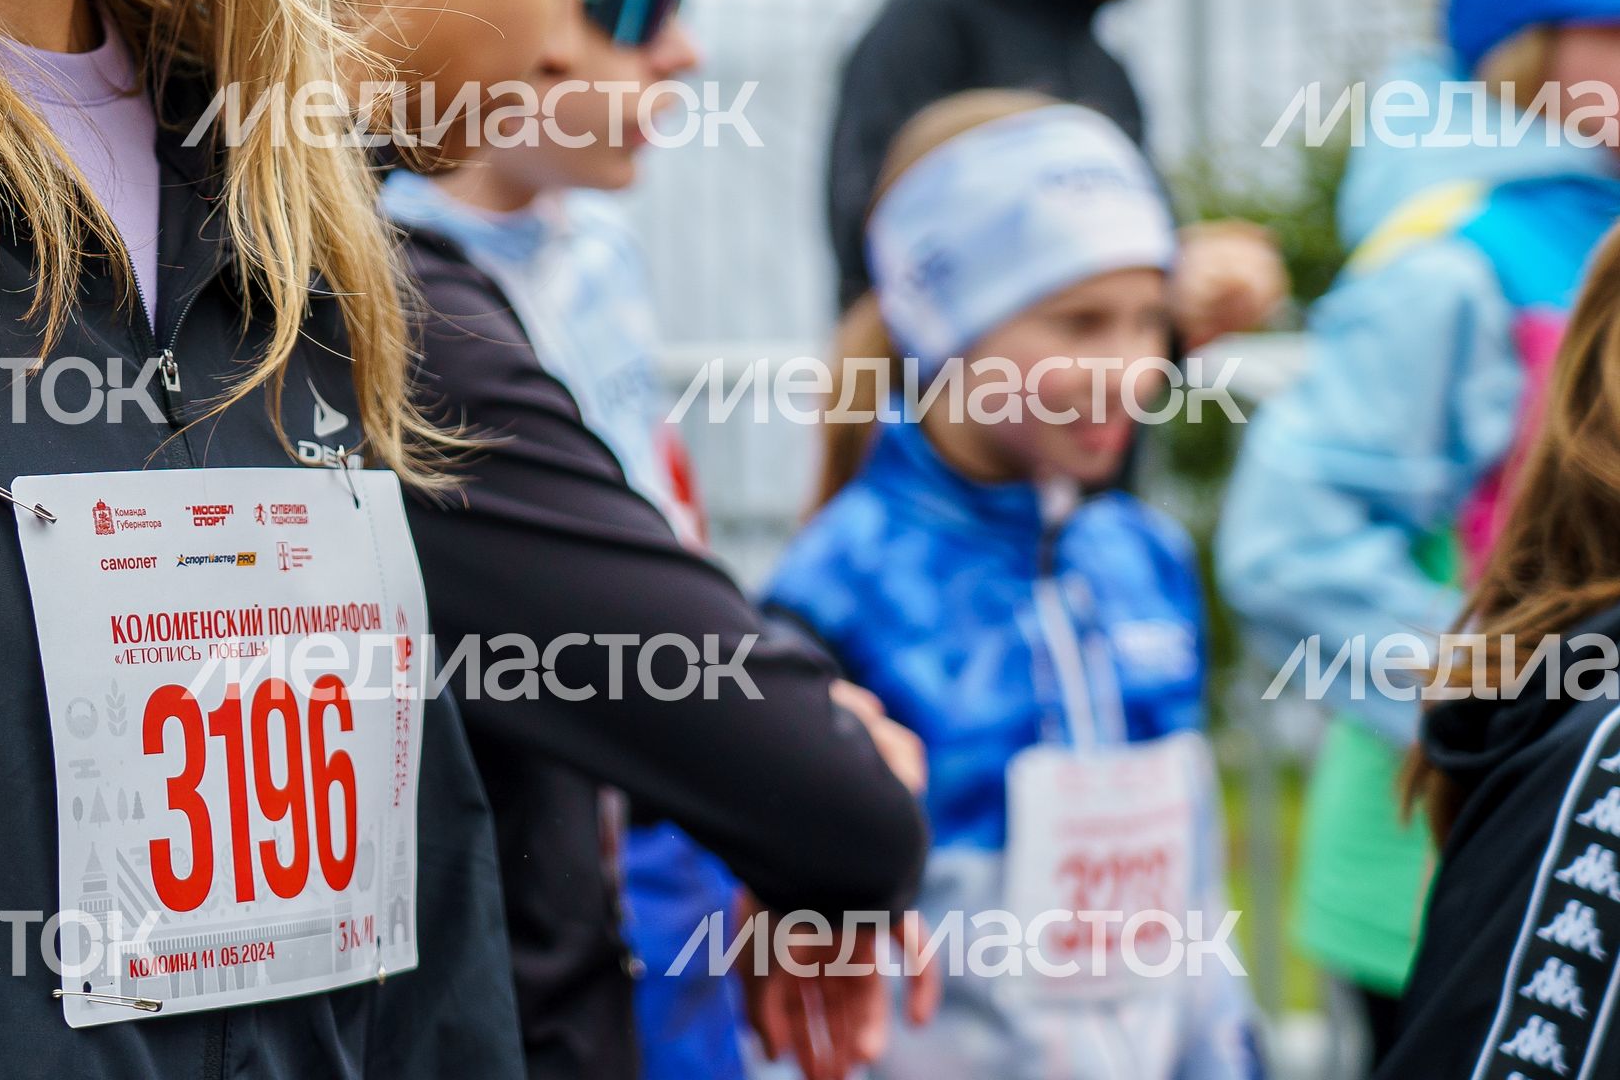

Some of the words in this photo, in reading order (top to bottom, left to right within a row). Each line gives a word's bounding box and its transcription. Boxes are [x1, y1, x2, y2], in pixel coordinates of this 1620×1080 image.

[114, 507, 147, 517] Команда
[192, 504, 234, 515] МОСОБЛ
[116, 519, 162, 531] Губернатора
[193, 516, 226, 526] СПОРТ
[100, 555, 158, 571] самолет
[237, 554, 256, 565] PRO
[111, 604, 264, 644] КОЛОМЕНСКИЙ
[268, 601, 382, 638] ПОЛУМАРАФОН
[142, 674, 357, 912] 3196
[129, 951, 197, 978] КОЛОМНА
